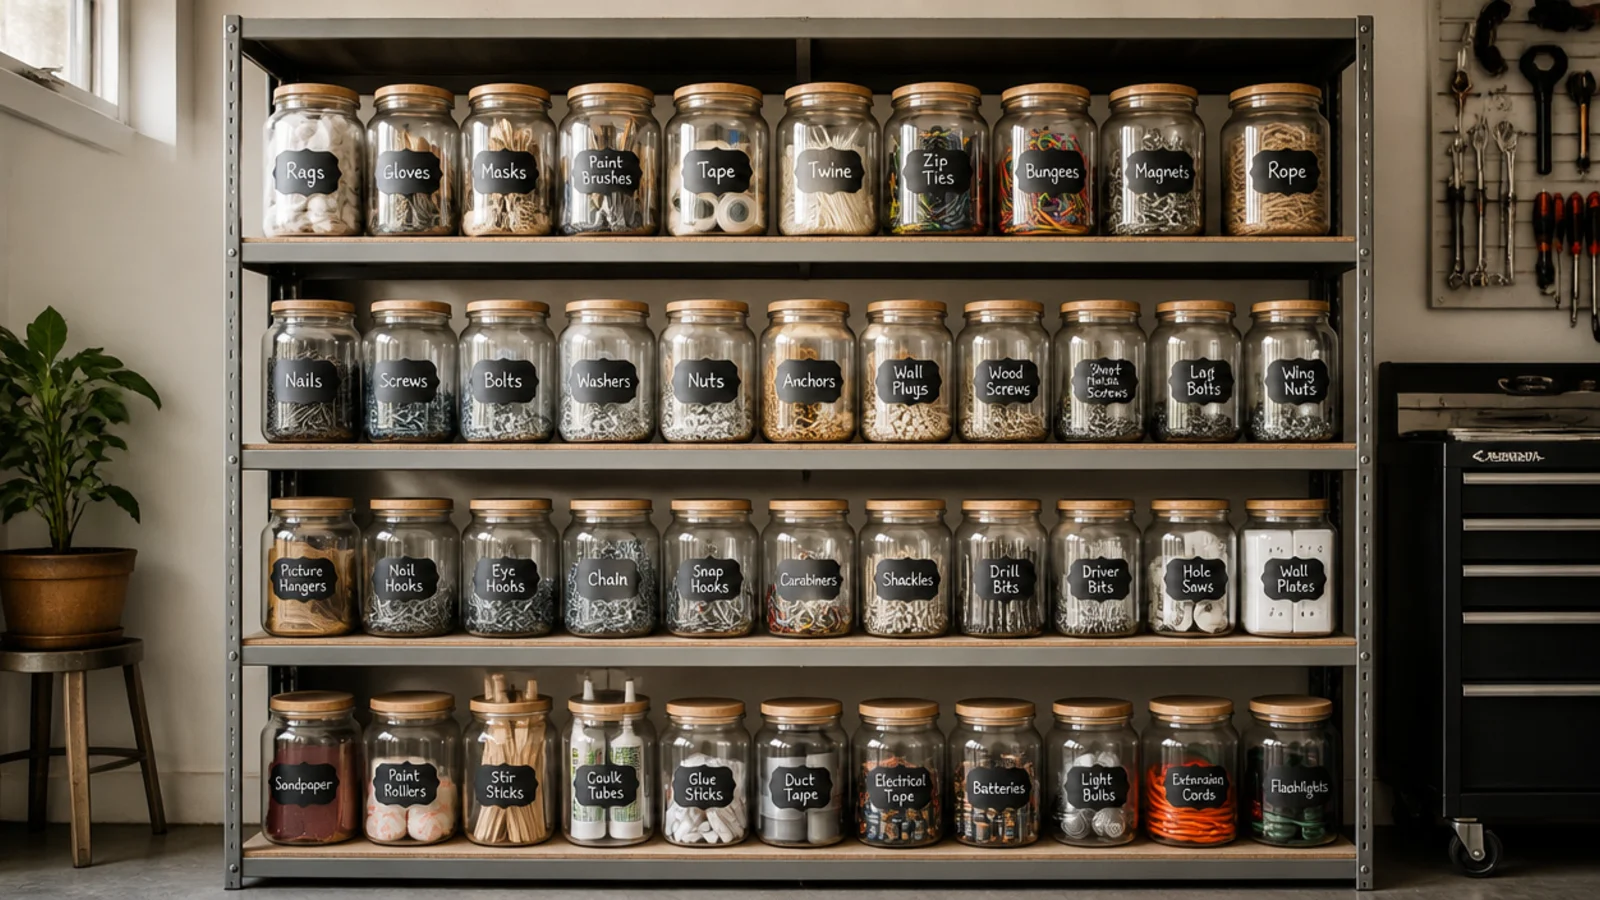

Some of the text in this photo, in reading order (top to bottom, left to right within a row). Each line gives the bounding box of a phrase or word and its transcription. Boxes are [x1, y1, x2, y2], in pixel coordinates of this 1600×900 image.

[590, 156, 622, 169] Paint
[923, 154, 947, 171] Zip
[286, 162, 324, 188] Rags
[384, 165, 430, 180] Gloves
[482, 164, 526, 180] Masks
[697, 161, 735, 183] Tape
[808, 162, 852, 179] Twine
[923, 170, 954, 185] Ties
[1026, 164, 1079, 185] Bungees
[1135, 163, 1189, 184] Magnets
[1269, 162, 1307, 185] Rope
[582, 172, 632, 184] Brushes
[894, 366, 922, 379] Wall
[989, 366, 1023, 379] Wood
[1282, 366, 1314, 383] Wing
[286, 373, 322, 388] Nails
[380, 374, 428, 388] Screws
[484, 372, 522, 388] Bolts
[577, 374, 630, 388] Washers
[688, 372, 724, 388] Nuts
[783, 372, 836, 388] Anchors
[986, 383, 1030, 396] Screws
[1285, 382, 1317, 396] Nuts
[281, 564, 322, 577] Picture
[390, 564, 415, 577] Nail
[694, 565, 723, 581] Snap
[990, 565, 1019, 578] Drill
[1083, 565, 1119, 578] Driver
[1280, 565, 1308, 578] Wall
[385, 578, 423, 592] Hooks
[588, 571, 628, 586] Chain
[781, 573, 837, 586] Carabiners
[883, 572, 933, 586] Shackles
[1278, 579, 1315, 592] Plates
[279, 579, 326, 595] Hangers
[691, 579, 729, 593] Hooks
[994, 579, 1019, 593] Bits
[1088, 579, 1114, 593] Bits
[1182, 580, 1214, 592] Saws
[389, 769, 420, 782] Paint
[492, 771, 516, 784] Stir
[587, 771, 622, 783] Caulk
[689, 772, 717, 787] Glue
[786, 773, 815, 786] Duct
[875, 773, 926, 787] Electrical
[1082, 773, 1112, 790] Light
[275, 777, 334, 794] Sandpaper
[487, 786, 524, 799] Sticks
[588, 786, 624, 799] Tubes
[973, 781, 1025, 795] Batteries
[685, 787, 723, 801] Sticks
[884, 790, 914, 806] Tape
[1083, 787, 1115, 801] Bulbs
[1183, 787, 1216, 801] Cords
